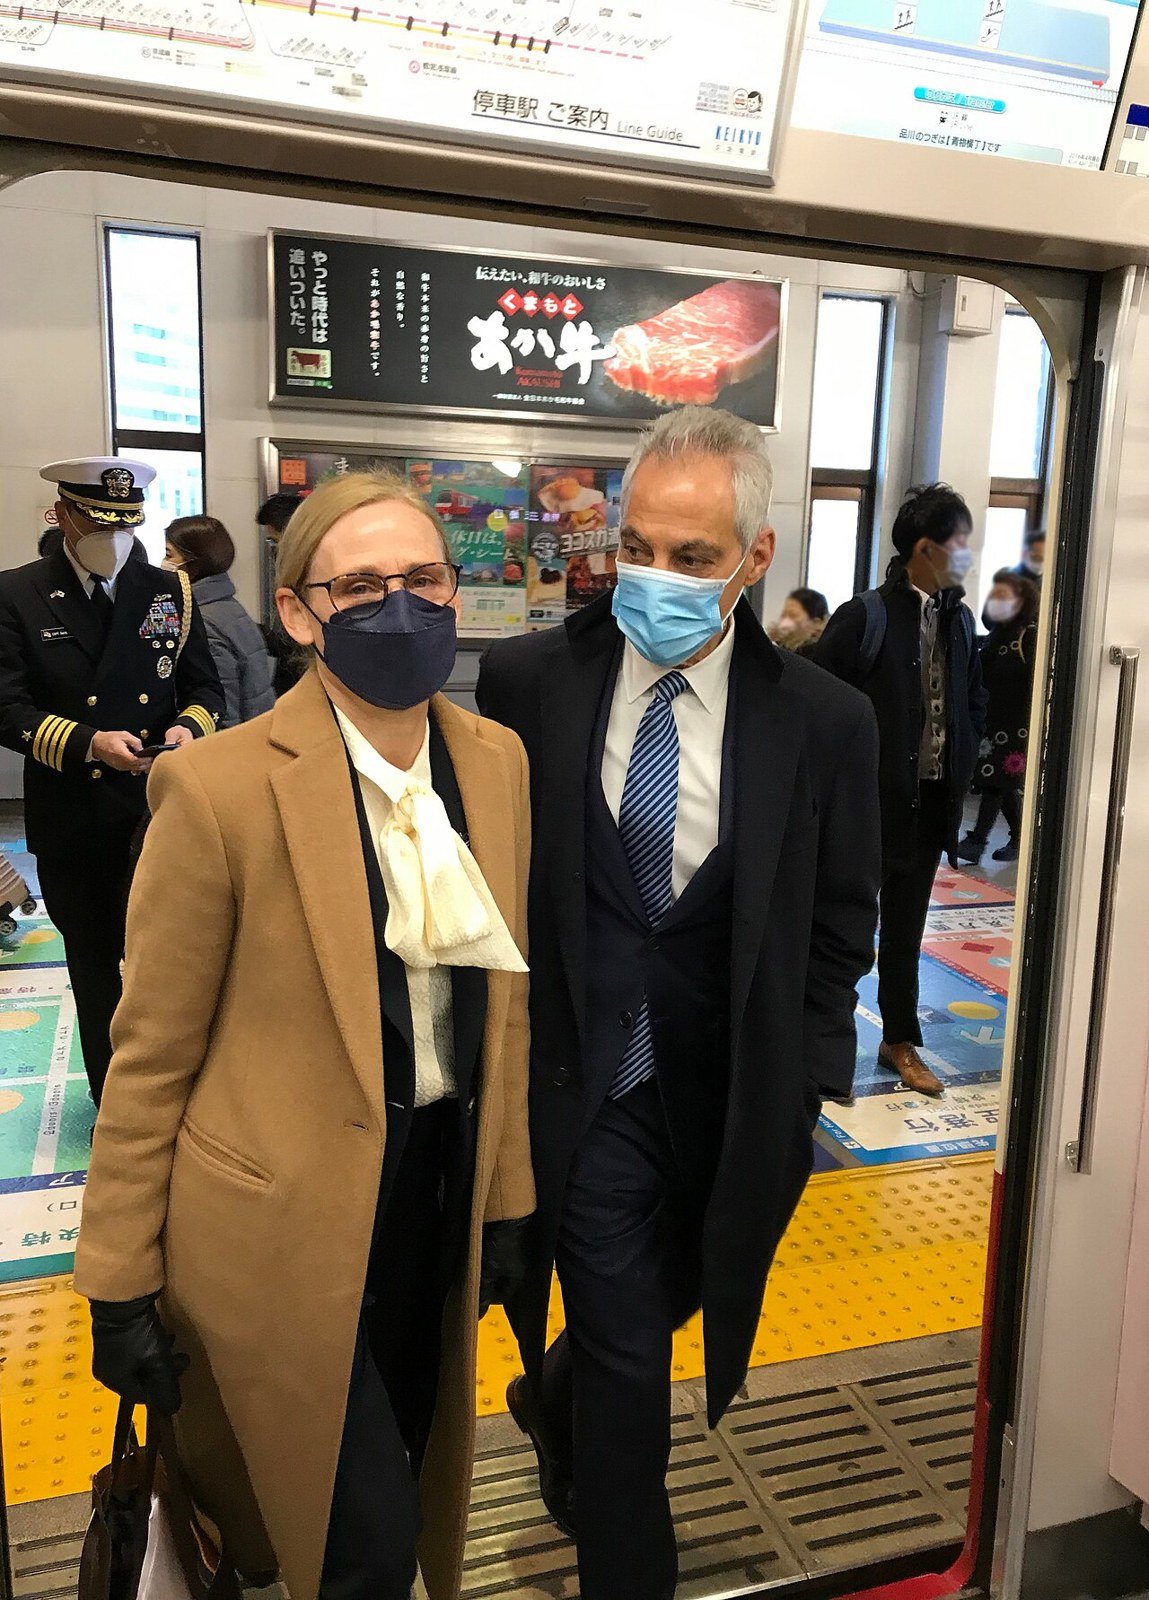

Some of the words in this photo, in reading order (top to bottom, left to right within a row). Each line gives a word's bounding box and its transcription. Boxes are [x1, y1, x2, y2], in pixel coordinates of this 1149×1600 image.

[472, 88, 540, 119] 停車駅
[546, 99, 610, 131] ご案内
[616, 119, 645, 137] Line
[646, 123, 685, 142] Guide
[715, 125, 762, 145] KEIKYU
[288, 247, 307, 335] 追いついた。
[311, 250, 329, 344] やっと時代は
[501, 293, 578, 316] くまもと
[466, 310, 618, 385] あか牛
